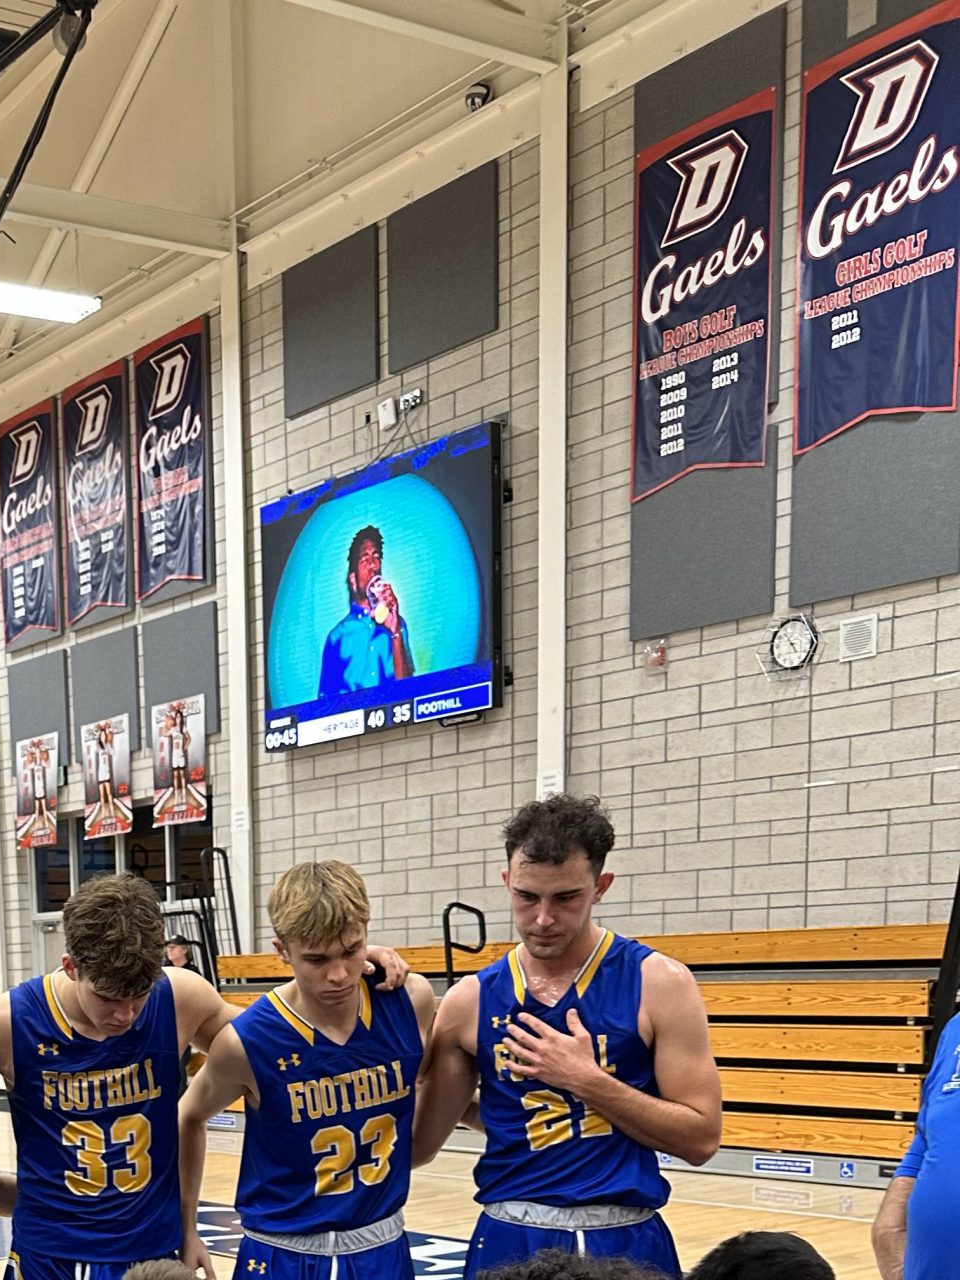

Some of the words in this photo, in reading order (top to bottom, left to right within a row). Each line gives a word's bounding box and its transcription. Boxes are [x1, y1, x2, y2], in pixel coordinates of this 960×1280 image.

[832, 39, 939, 174] D
[661, 129, 748, 248] D
[805, 135, 959, 260] Gaels
[640, 217, 765, 325] Gaels
[804, 287, 851, 319] LEAGUE
[852, 248, 955, 303] CHAMPIONSHIPS
[836, 247, 881, 286] GIRLS
[883, 229, 928, 268] GOLF
[640, 352, 677, 380] LEAGUE
[678, 319, 764, 366] CHAMPIONSHIPS
[663, 319, 698, 352] BOYS
[700, 305, 736, 338] GOLF
[831, 310, 859, 330] 2011
[831, 327, 861, 349] 2012
[147, 343, 191, 420] D
[711, 369, 739, 390] 2014
[712, 352, 738, 372] 2013
[75, 384, 113, 457] D
[140, 405, 201, 473] Gaels
[660, 405, 685, 423] 2010
[660, 422, 683, 440] 2011
[9, 420, 43, 487] D
[68, 442, 122, 506] Gaels
[660, 438, 685, 457] 2012
[2, 475, 52, 534] Gaels
[367, 709, 385, 728] 40
[392, 704, 411, 723] 35
[417, 697, 462, 715] FOOTHILL
[41, 1058, 162, 1111] FOOTHILL
[286, 1059, 411, 1125] FOOTHILL
[61, 1113, 152, 1197] 33
[310, 1112, 398, 1197] 23
